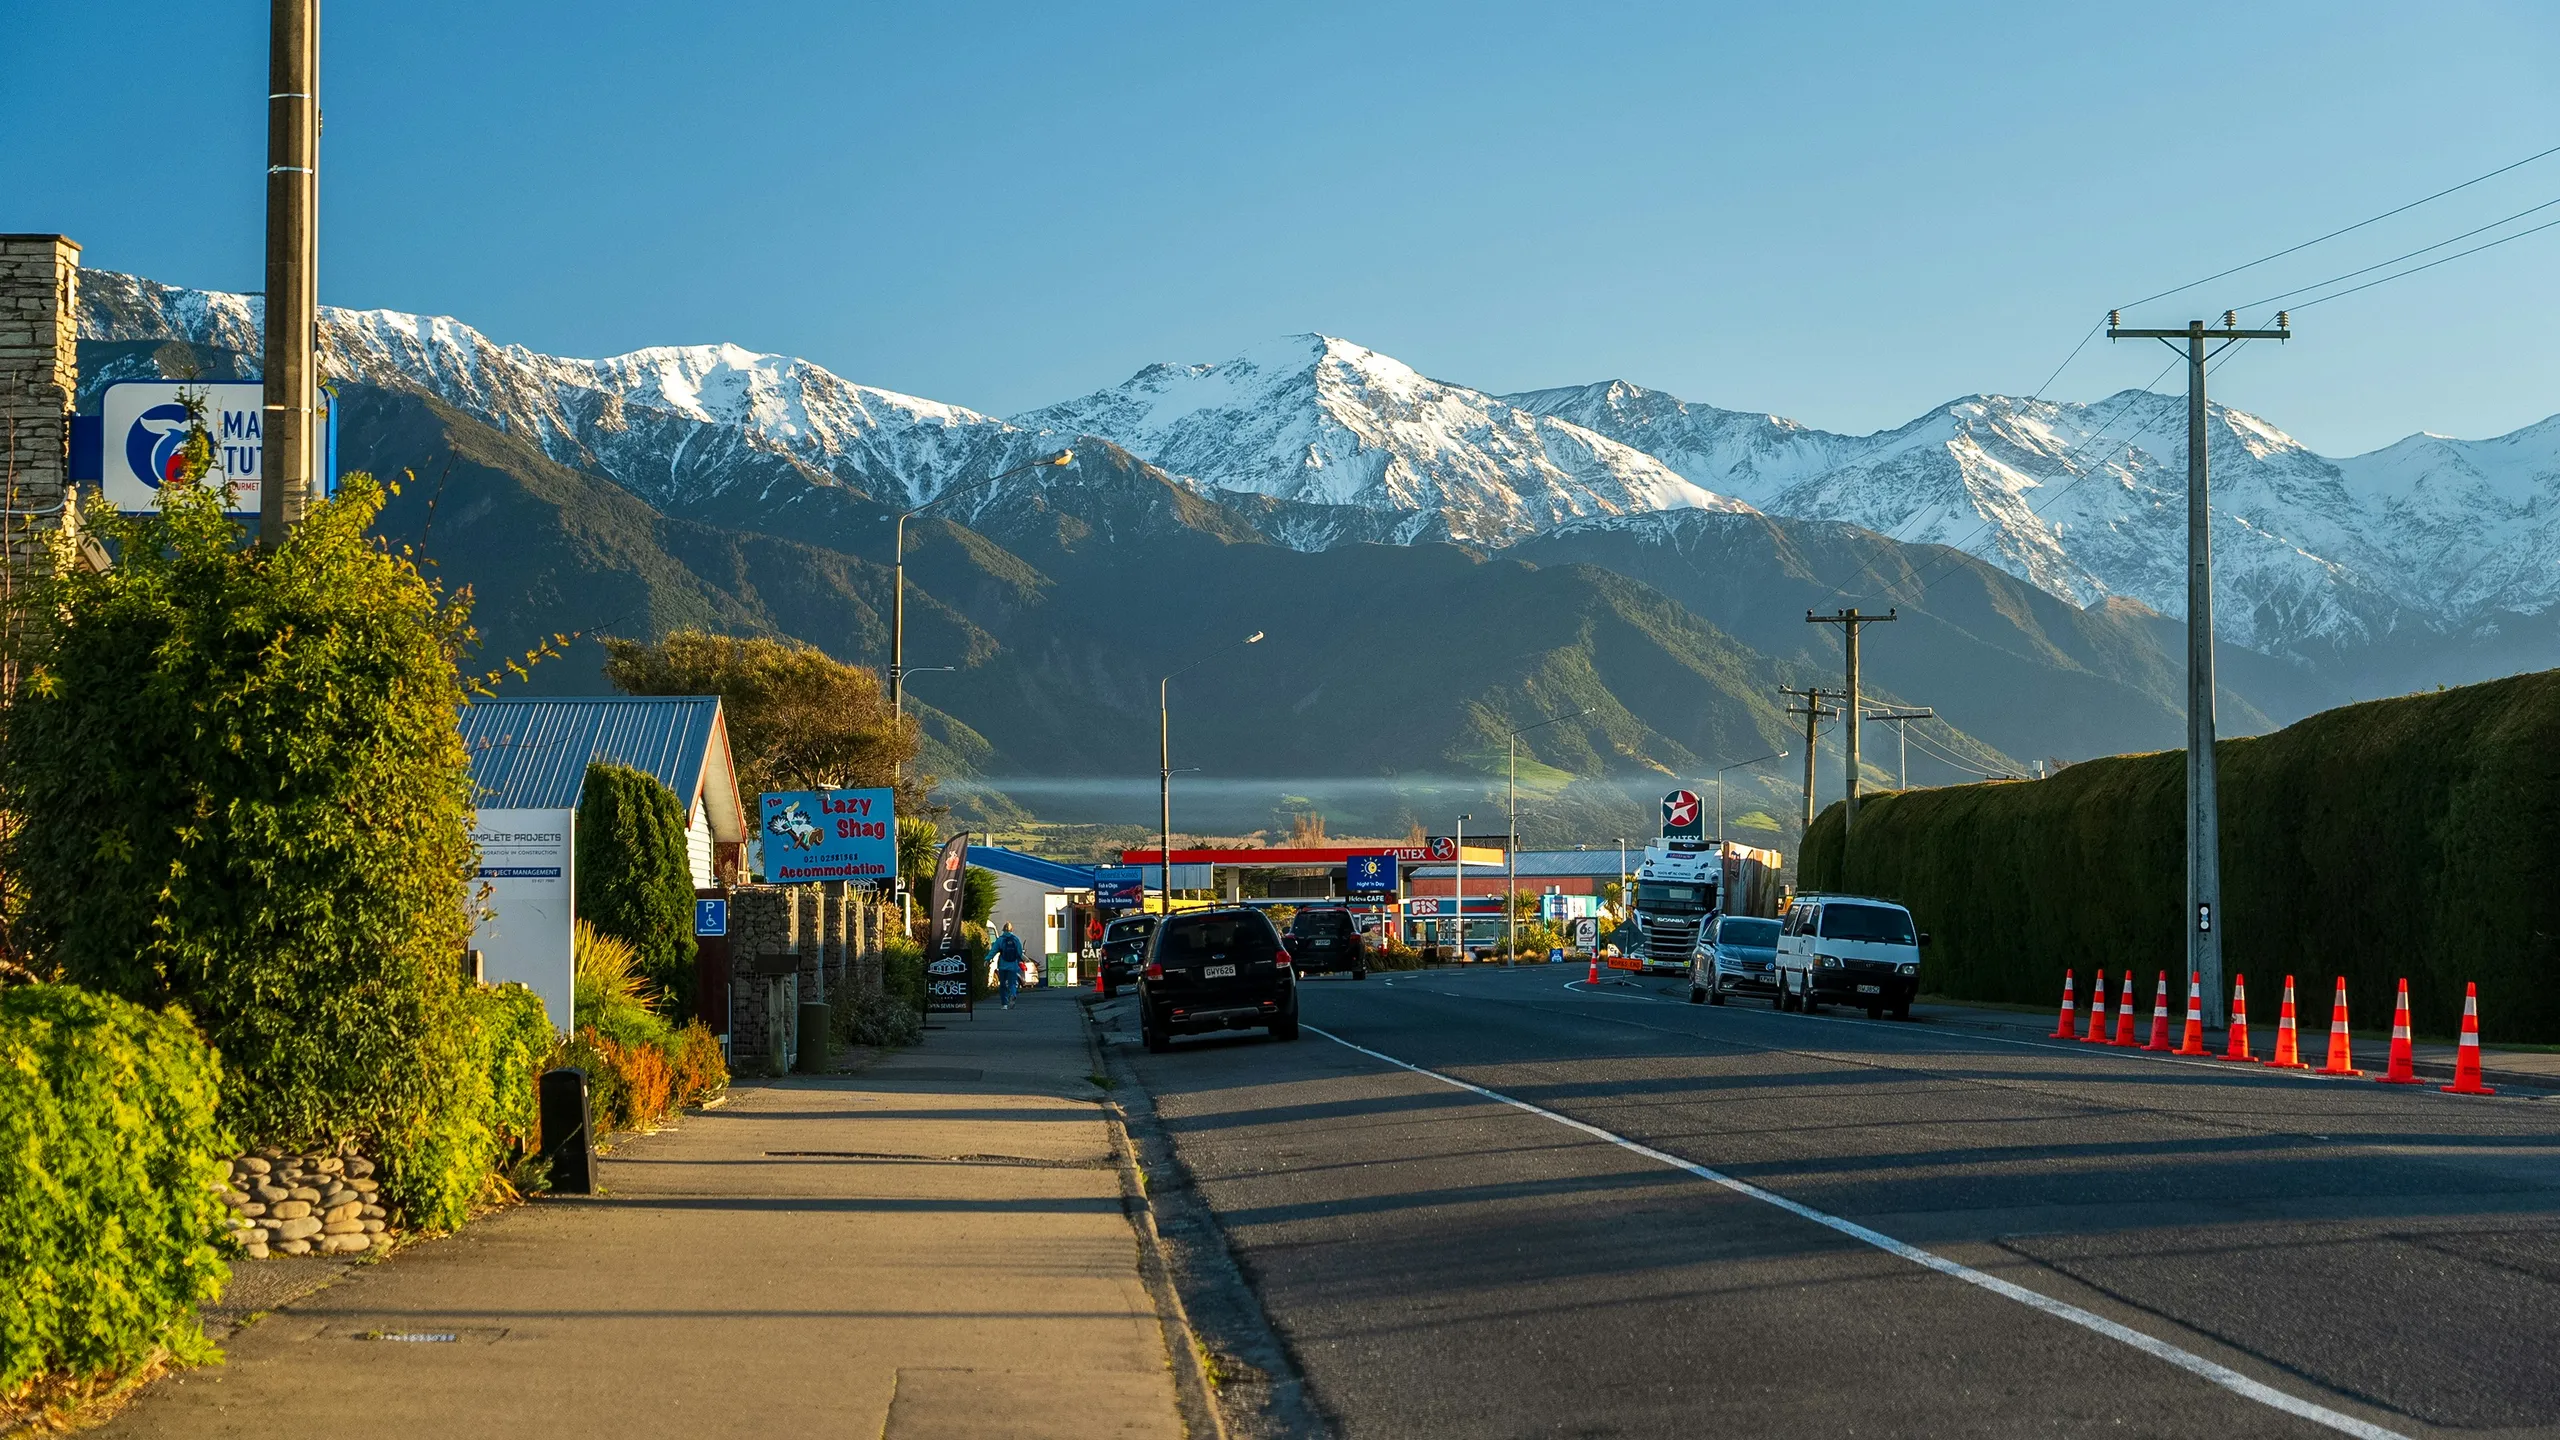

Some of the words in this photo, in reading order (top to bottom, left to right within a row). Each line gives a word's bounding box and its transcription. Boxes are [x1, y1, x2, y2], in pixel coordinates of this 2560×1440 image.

[223, 411, 263, 440] MA
[231, 482, 260, 491] OURMET
[767, 798, 783, 808] The
[821, 798, 872, 816] Lazy
[836, 818, 886, 840] Shag
[468, 833, 511, 842] OMPLETE
[514, 833, 562, 842] PROJECTS
[803, 855, 818, 863] 021
[1383, 849, 1426, 859] CALTEX
[779, 863, 885, 879] Accommodation
[705, 902, 715, 912] P
[1081, 948, 1101, 959] CAF
[1206, 967, 1235, 977] GWY626
[928, 982, 967, 995] HOUSE
